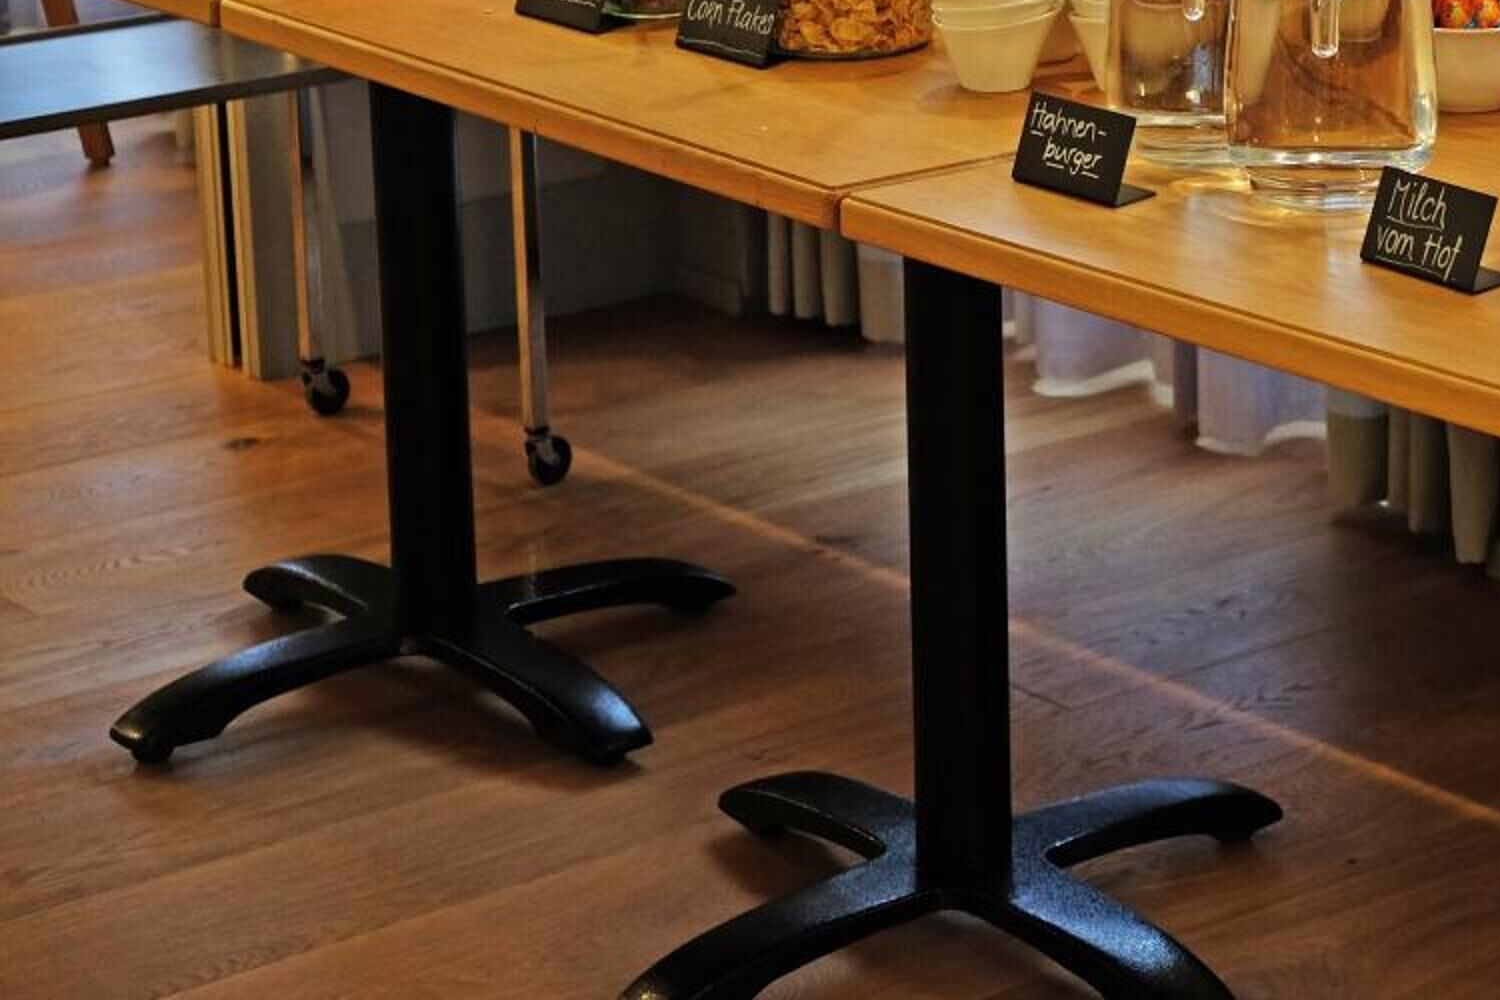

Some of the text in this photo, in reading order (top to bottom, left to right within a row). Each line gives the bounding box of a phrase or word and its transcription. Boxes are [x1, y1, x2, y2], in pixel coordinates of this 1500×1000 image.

[726, 0, 776, 35] Flakes
[1030, 101, 1107, 143] Hahnen-
[1042, 136, 1104, 176] burger
[1386, 179, 1448, 231] Milch
[1376, 223, 1464, 282] vom Hof
